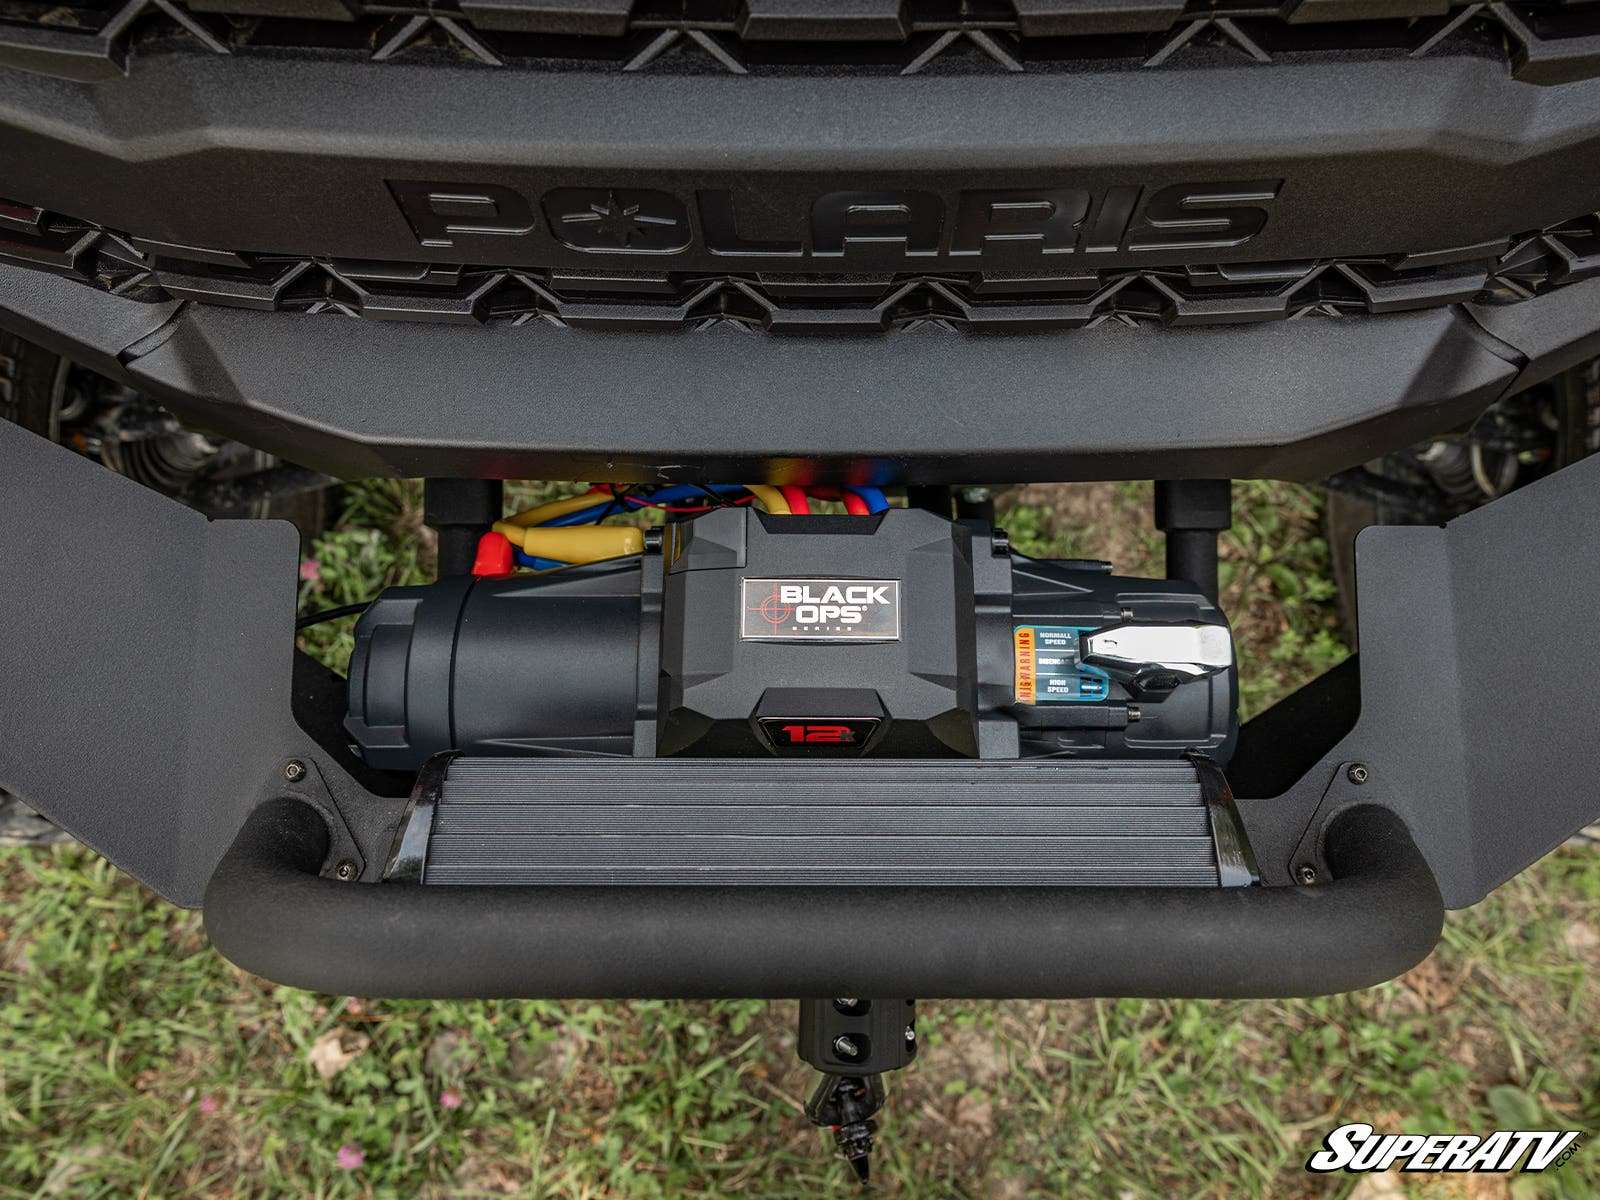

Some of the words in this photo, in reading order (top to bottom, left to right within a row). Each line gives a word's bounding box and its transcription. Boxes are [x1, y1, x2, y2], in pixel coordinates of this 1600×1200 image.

[384, 178, 1286, 257] POLARIS
[780, 585, 891, 604] BLACK
[795, 605, 863, 624] OPS
[1047, 686, 1069, 694] SPEED
